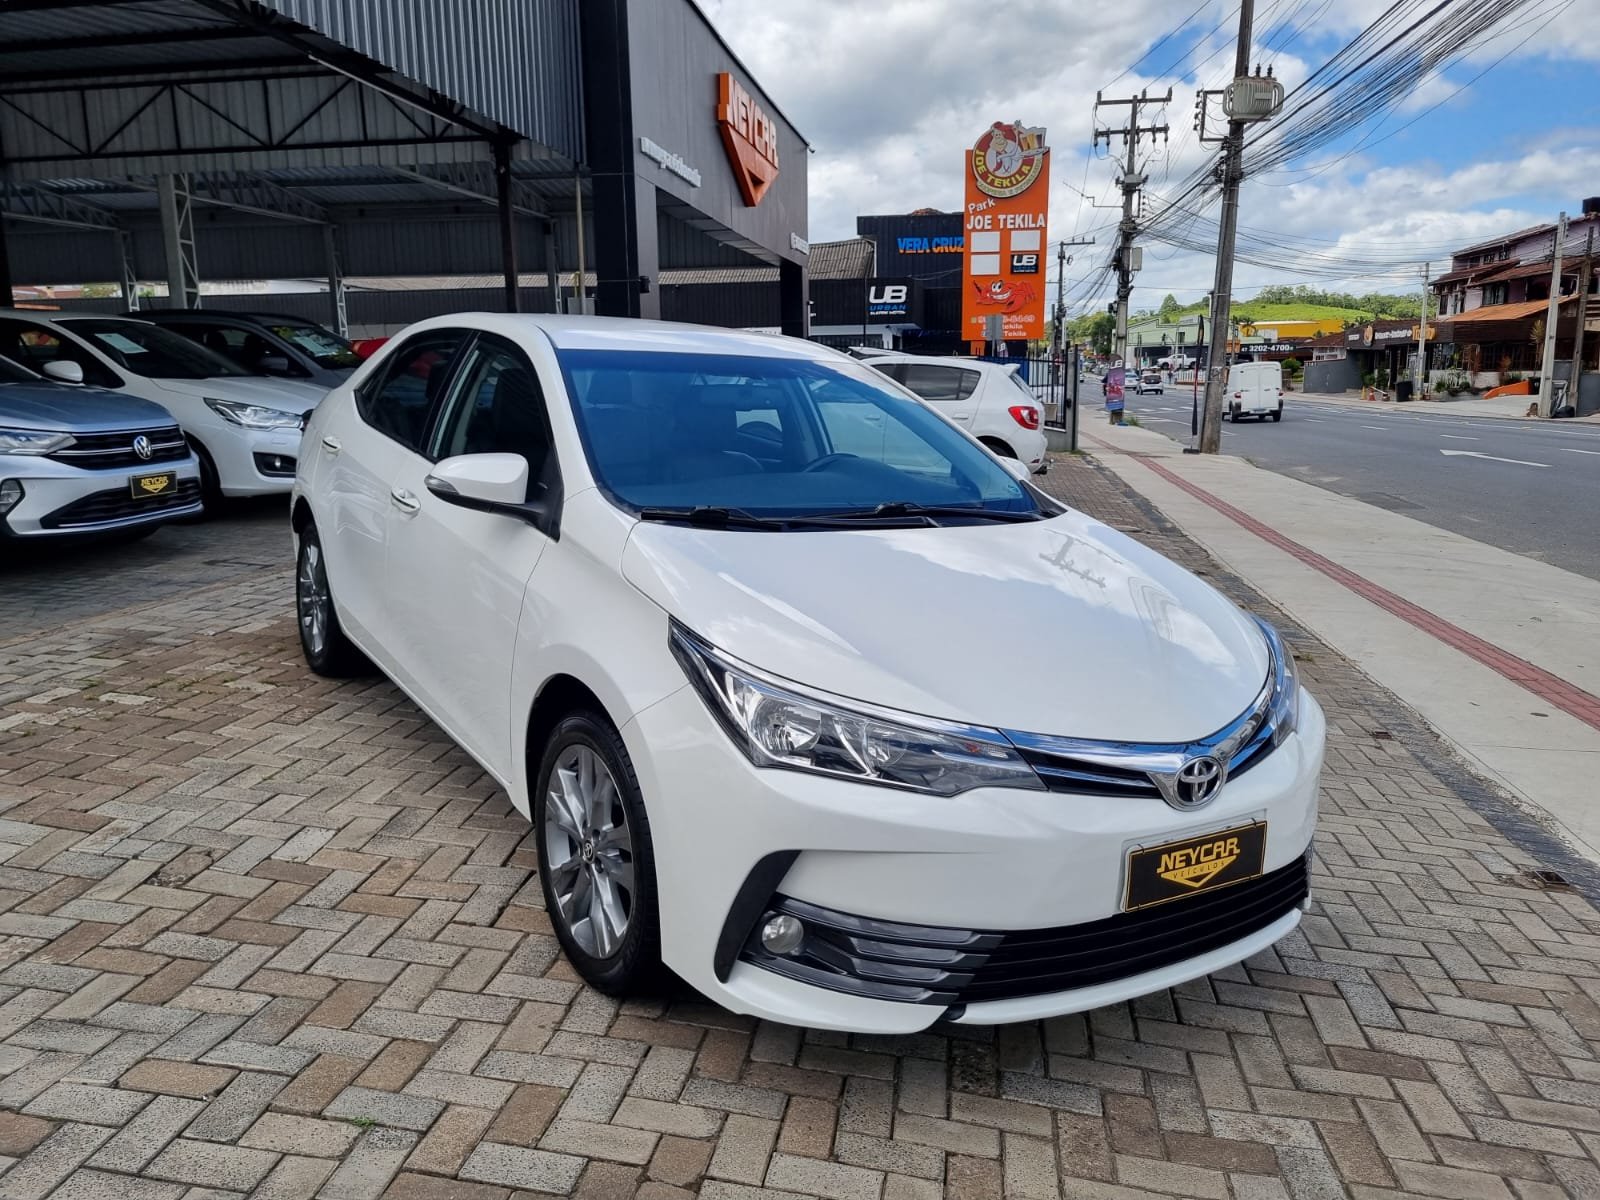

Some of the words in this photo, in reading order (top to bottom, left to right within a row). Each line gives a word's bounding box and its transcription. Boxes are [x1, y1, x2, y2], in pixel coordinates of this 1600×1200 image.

[723, 73, 779, 170] NEYCAR
[975, 150, 987, 174] JOE
[986, 165, 1032, 188] TEKILA
[968, 198, 996, 214] Park
[966, 215, 992, 230] JOE
[998, 213, 1047, 229] TEKILA
[897, 237, 929, 253] VERA
[932, 237, 964, 253] CRUZ
[1013, 254, 1037, 266] UB
[869, 285, 907, 304] UB
[1249, 344, 1290, 352] 3202-4700
[1157, 838, 1240, 873] NEYCAR
